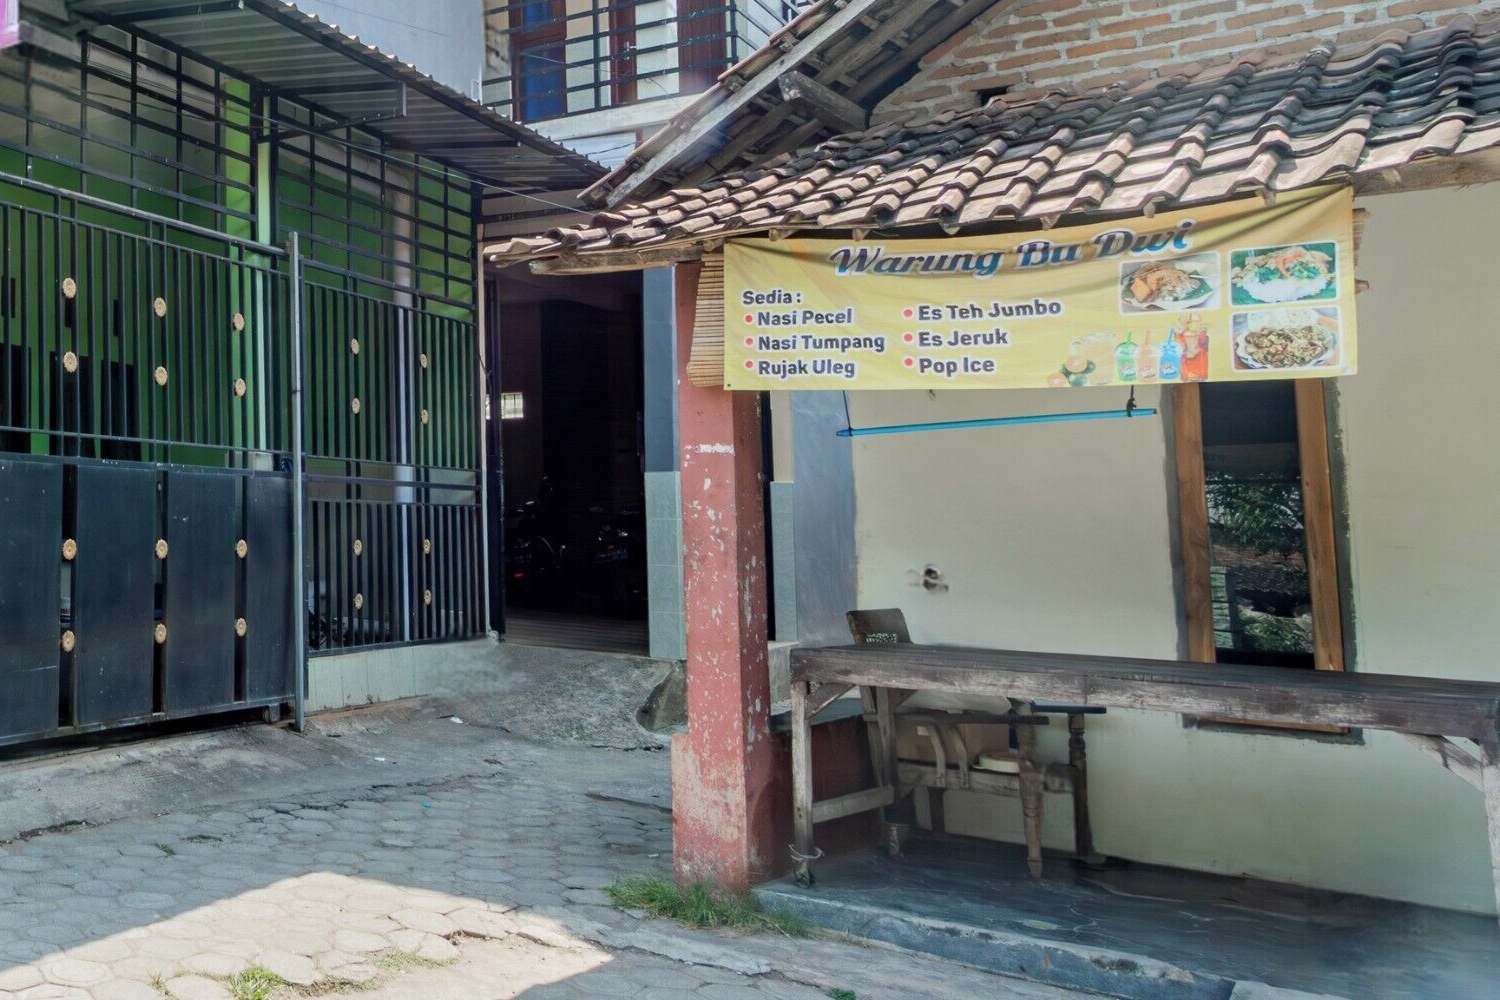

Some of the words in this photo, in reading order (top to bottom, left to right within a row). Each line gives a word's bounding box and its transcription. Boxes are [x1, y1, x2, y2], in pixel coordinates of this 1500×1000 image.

[829, 247, 1002, 277] Warung
[1015, 241, 1081, 267] Bu
[1093, 222, 1194, 254] Dwi
[757, 310, 797, 326] Nasi
[801, 308, 853, 325] Pecel
[918, 305, 943, 321] Es
[945, 304, 984, 319] Teh
[987, 298, 1062, 318] Jumbo
[758, 335, 797, 351] Nasi
[800, 334, 885, 353] Tumpang
[918, 331, 943, 347] Es
[947, 328, 1009, 346] Jeruk
[758, 359, 809, 379] Rujak
[812, 358, 856, 378] Uleg
[919, 357, 958, 378] Pop
[963, 356, 995, 373] Ice
